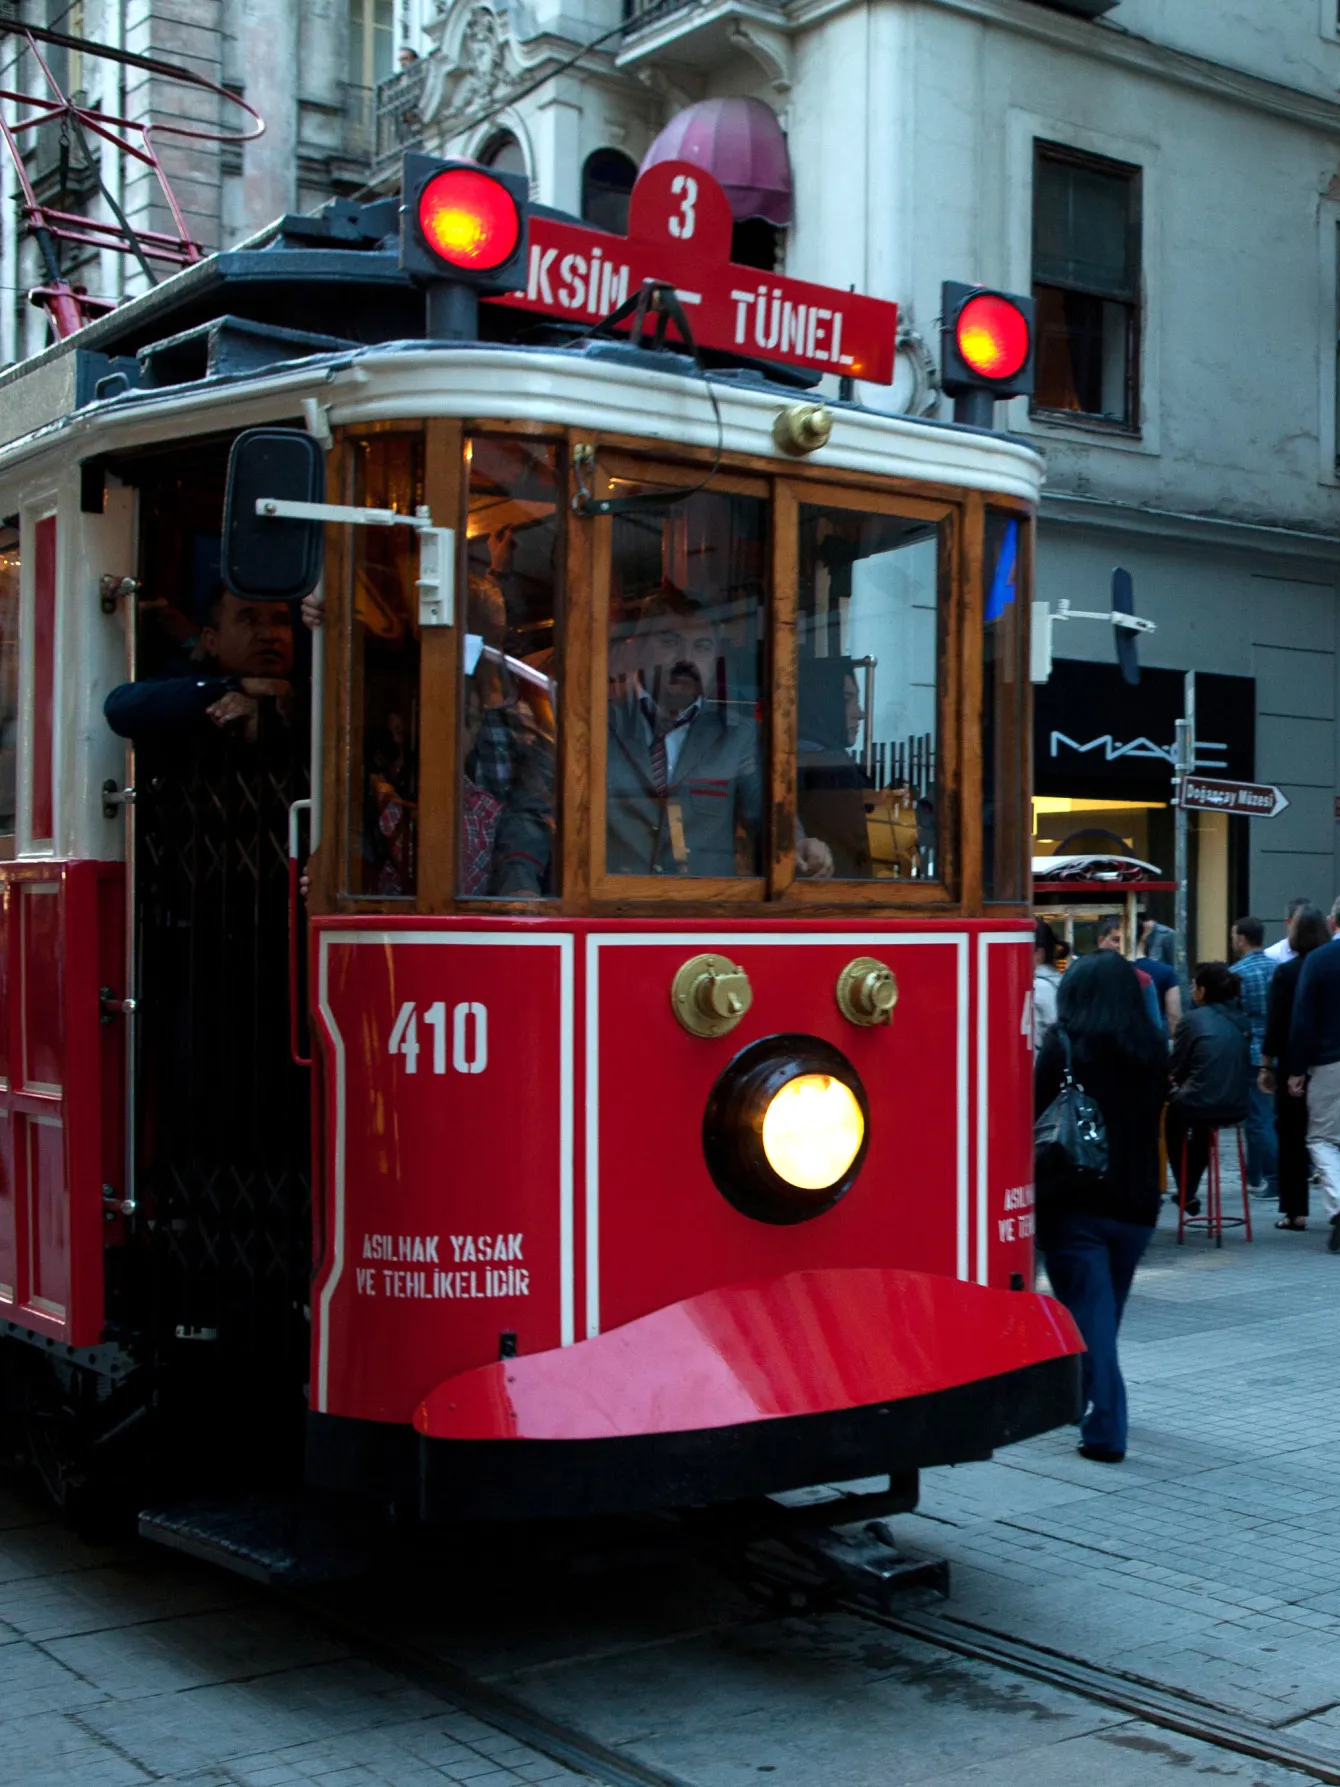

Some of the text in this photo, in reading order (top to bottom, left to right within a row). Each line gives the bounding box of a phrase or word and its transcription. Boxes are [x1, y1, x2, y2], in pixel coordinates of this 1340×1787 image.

[668, 174, 698, 239] 3
[517, 244, 630, 317] KSİM
[730, 285, 855, 366] TÜNEL
[1239, 791, 1274, 809] Müzesi
[387, 1001, 489, 1075] 410
[449, 1232, 525, 1263] YASAK
[356, 1265, 531, 1299] VE TEHLİKELİDİR
